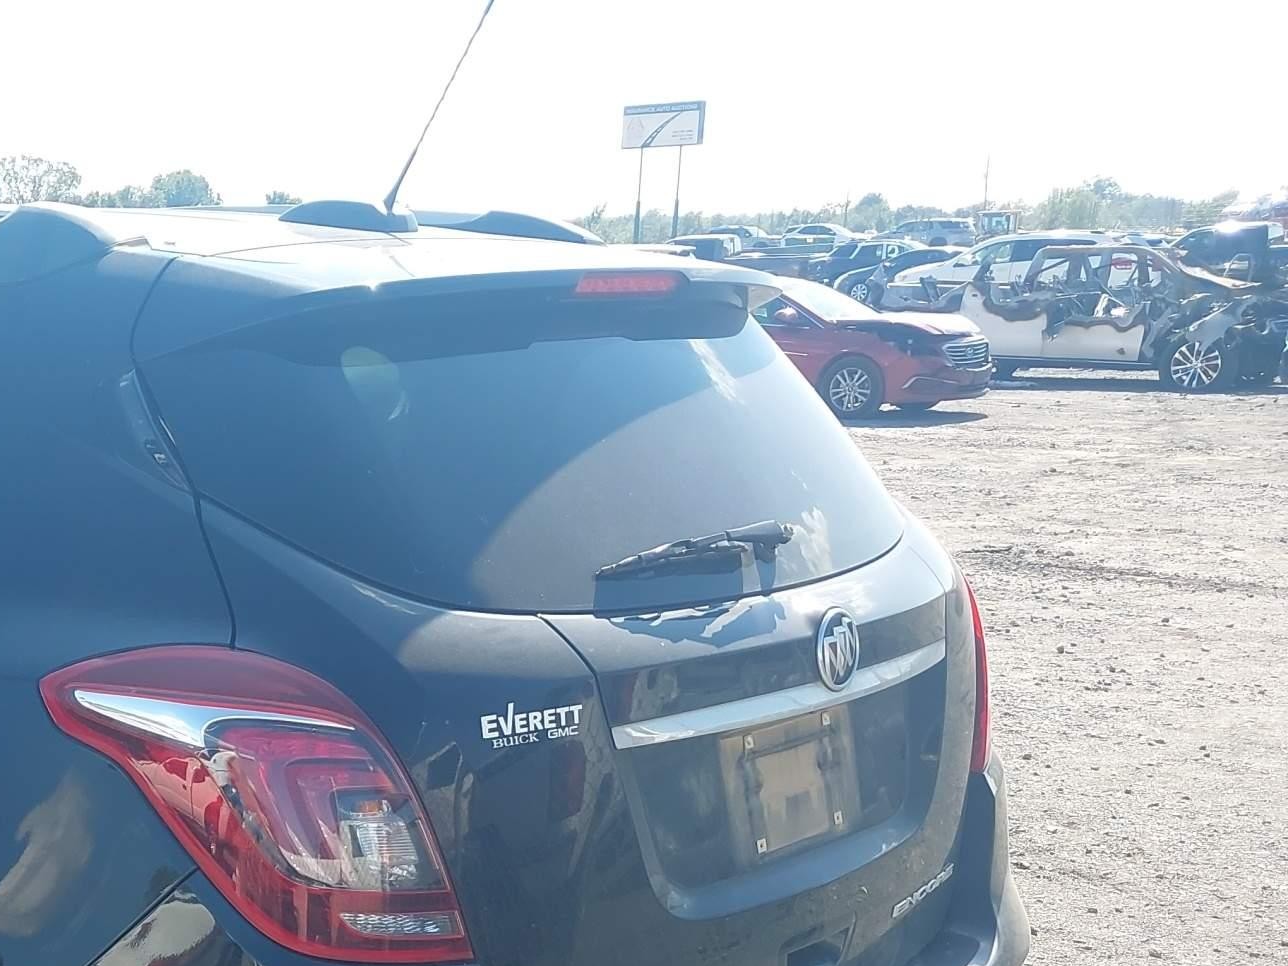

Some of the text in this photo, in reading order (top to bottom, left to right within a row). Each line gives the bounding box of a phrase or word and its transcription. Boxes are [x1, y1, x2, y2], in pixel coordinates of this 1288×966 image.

[480, 702, 583, 739] EVERETT
[492, 725, 580, 749] BUICK GMC
[892, 863, 954, 918] ENCORE
